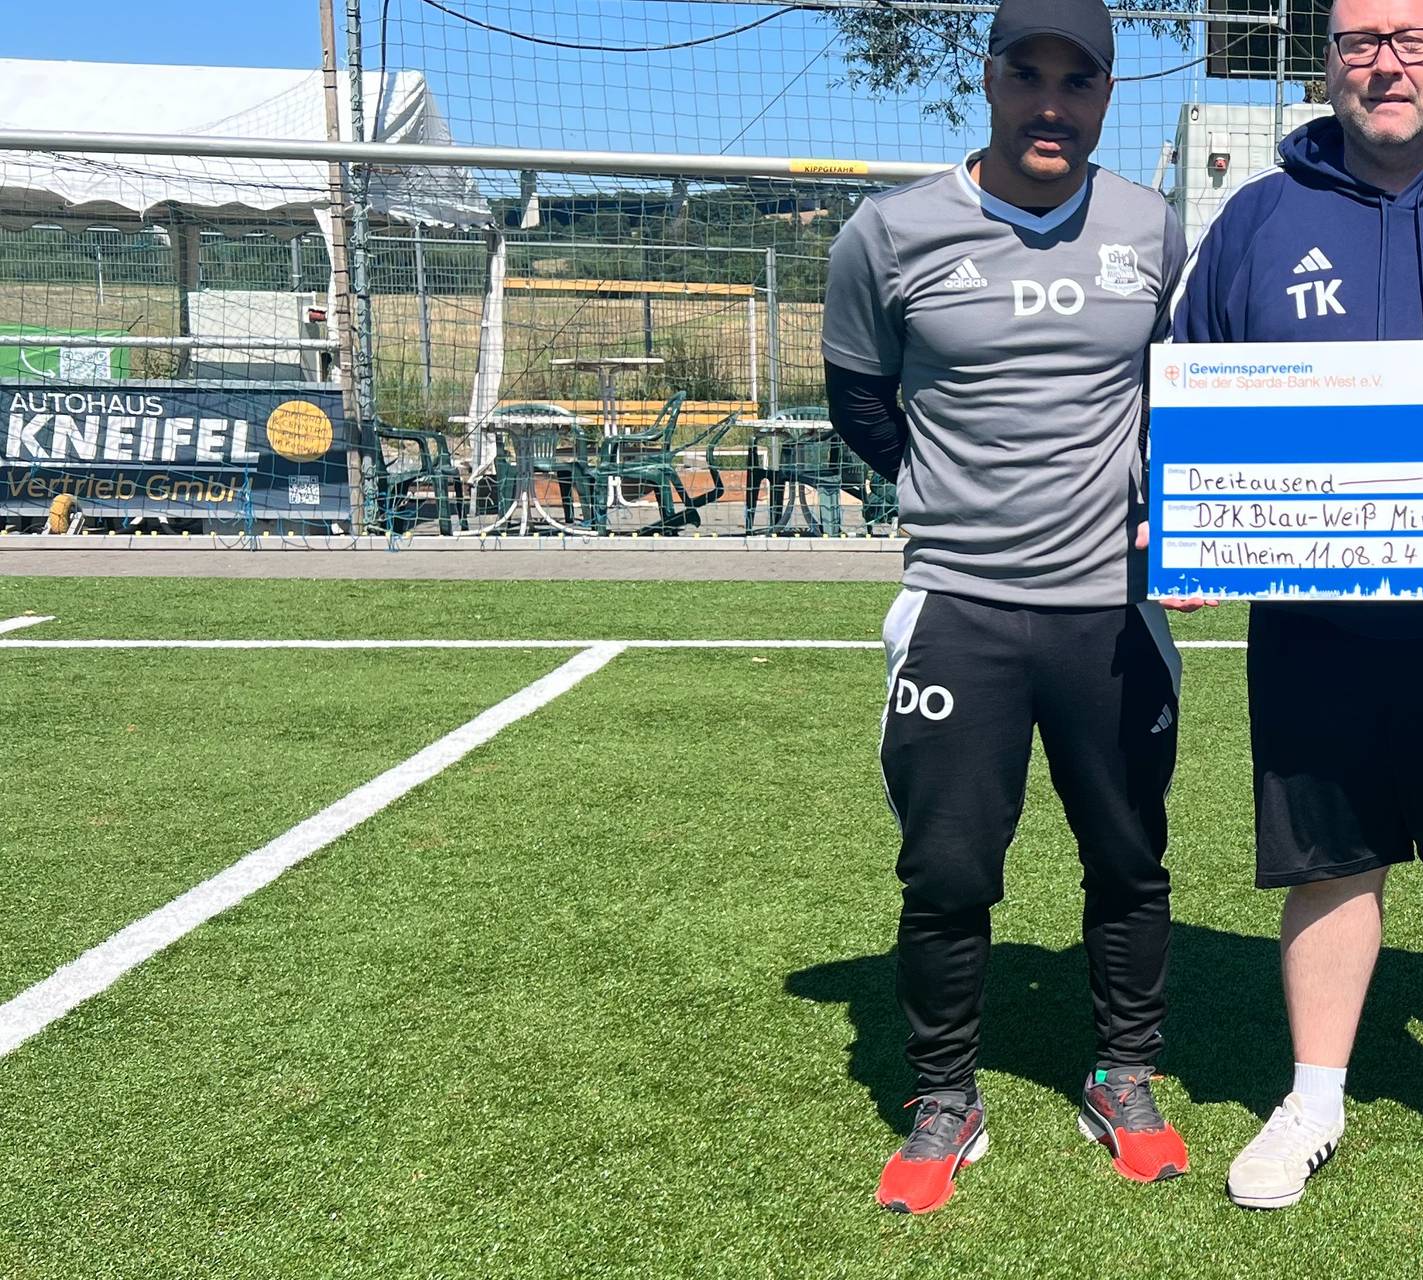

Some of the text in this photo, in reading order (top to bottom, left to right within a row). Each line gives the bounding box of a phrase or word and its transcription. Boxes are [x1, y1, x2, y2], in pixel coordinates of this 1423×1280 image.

[943, 277, 988, 289] adidas
[1011, 278, 1086, 316] DO
[1286, 279, 1347, 320] TK
[1189, 362, 1313, 376] Gewinnsparverein
[1189, 375, 1383, 390] bei der Sparda-Bank West e.V.
[10, 392, 163, 415] AUTOHAUS
[5, 413, 260, 463] KNEIFEL
[7, 471, 254, 502] Vertrieb GmbH
[1189, 467, 1335, 494] Dreitausend
[1249, 502, 1377, 531] Blau-Weiß
[1200, 540, 1302, 570] Mülheim,
[895, 678, 954, 721] DO
